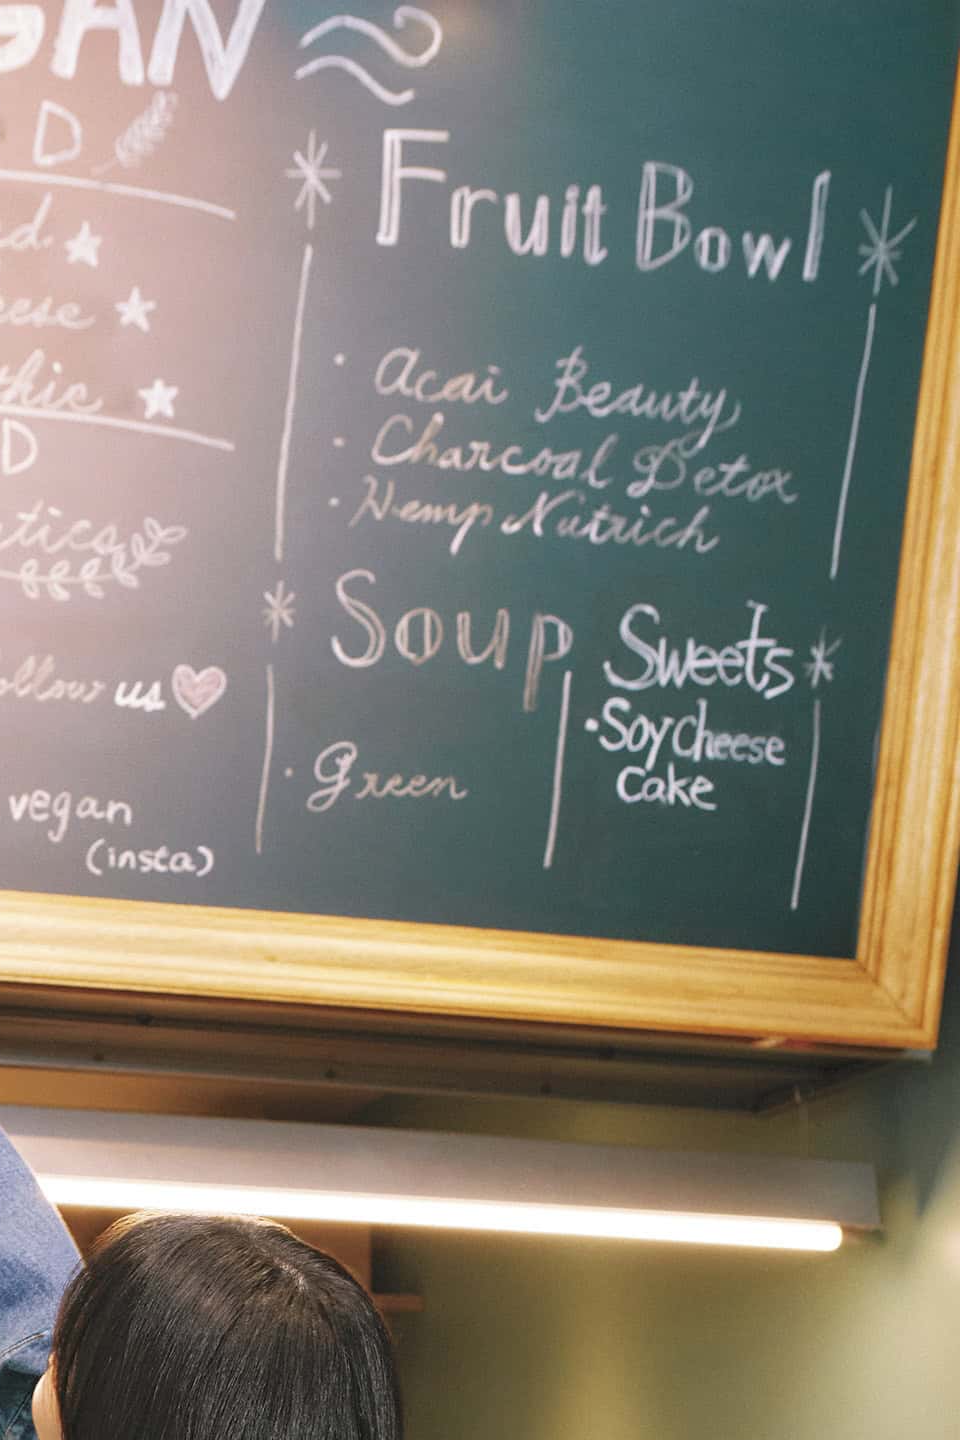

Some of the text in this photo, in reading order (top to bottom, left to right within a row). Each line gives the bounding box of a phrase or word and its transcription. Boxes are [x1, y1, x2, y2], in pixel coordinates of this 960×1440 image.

[376, 129, 832, 282] Fruit Bowl
[375, 346, 741, 457] Acai Beauty
[370, 412, 799, 504] Charcoal Detox
[350, 475, 493, 556] Hemp
[332, 569, 574, 712] Soup
[603, 600, 794, 699] Sweets
[113, 681, 167, 712] us
[307, 741, 466, 813] Green
[616, 762, 716, 810] Cake
[85, 839, 215, 876] (insta)
